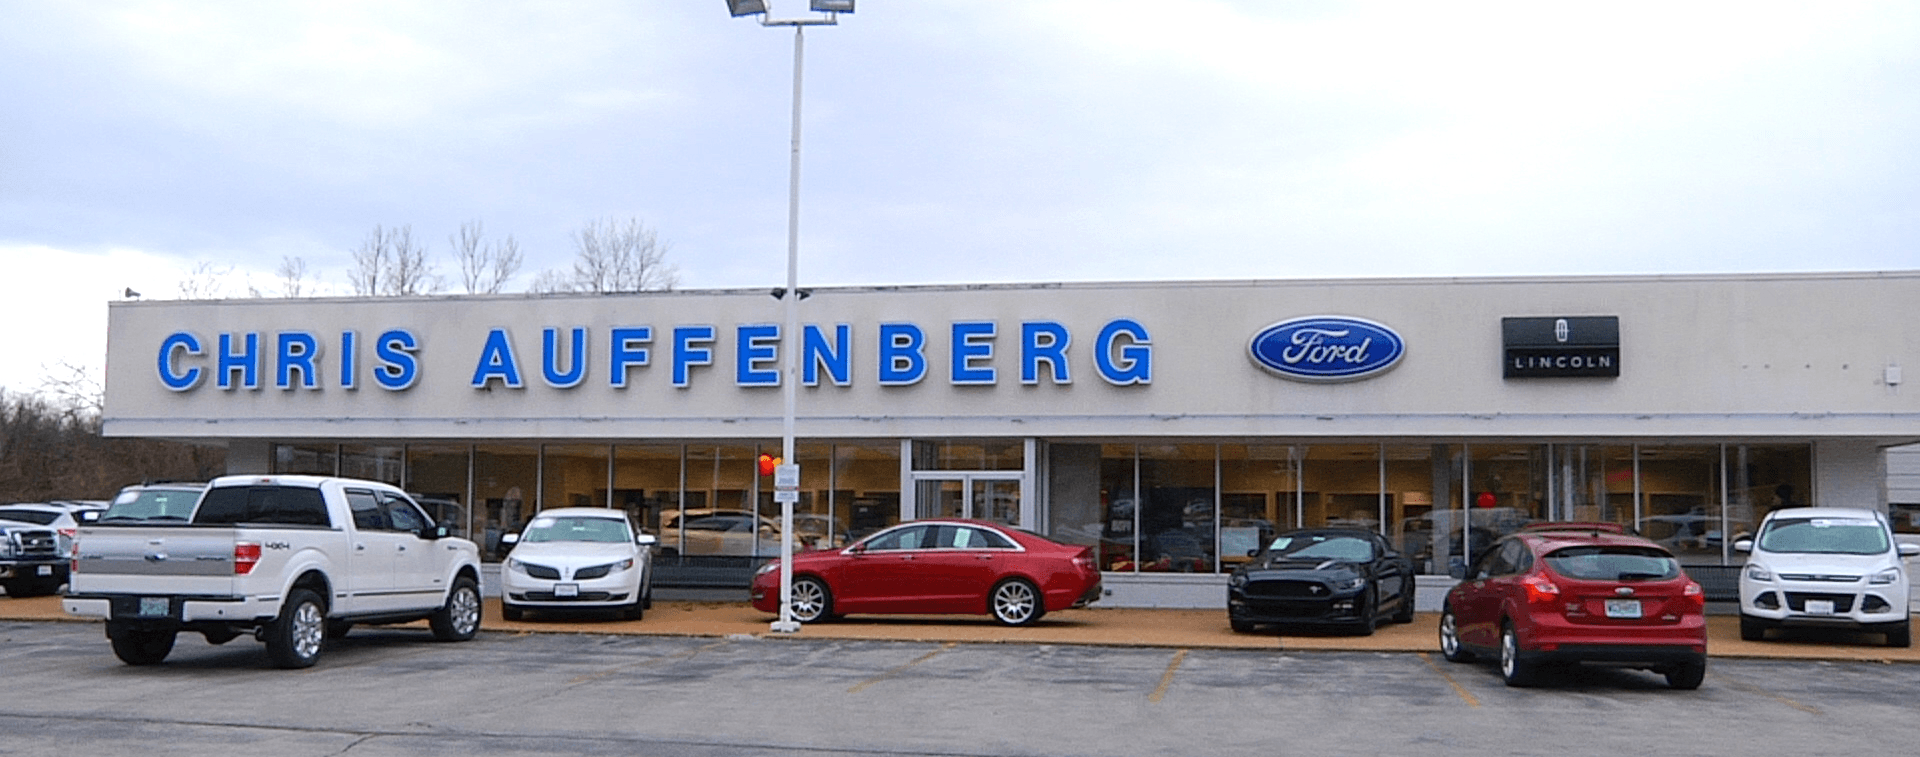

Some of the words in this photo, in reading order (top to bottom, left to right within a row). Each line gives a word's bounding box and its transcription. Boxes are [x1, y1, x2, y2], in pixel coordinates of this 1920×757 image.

[157, 329, 420, 391] CHRIS
[471, 318, 1153, 387] AUFFENBERG
[1282, 328, 1370, 365] Ford
[1515, 355, 1611, 369] LINCOLN
